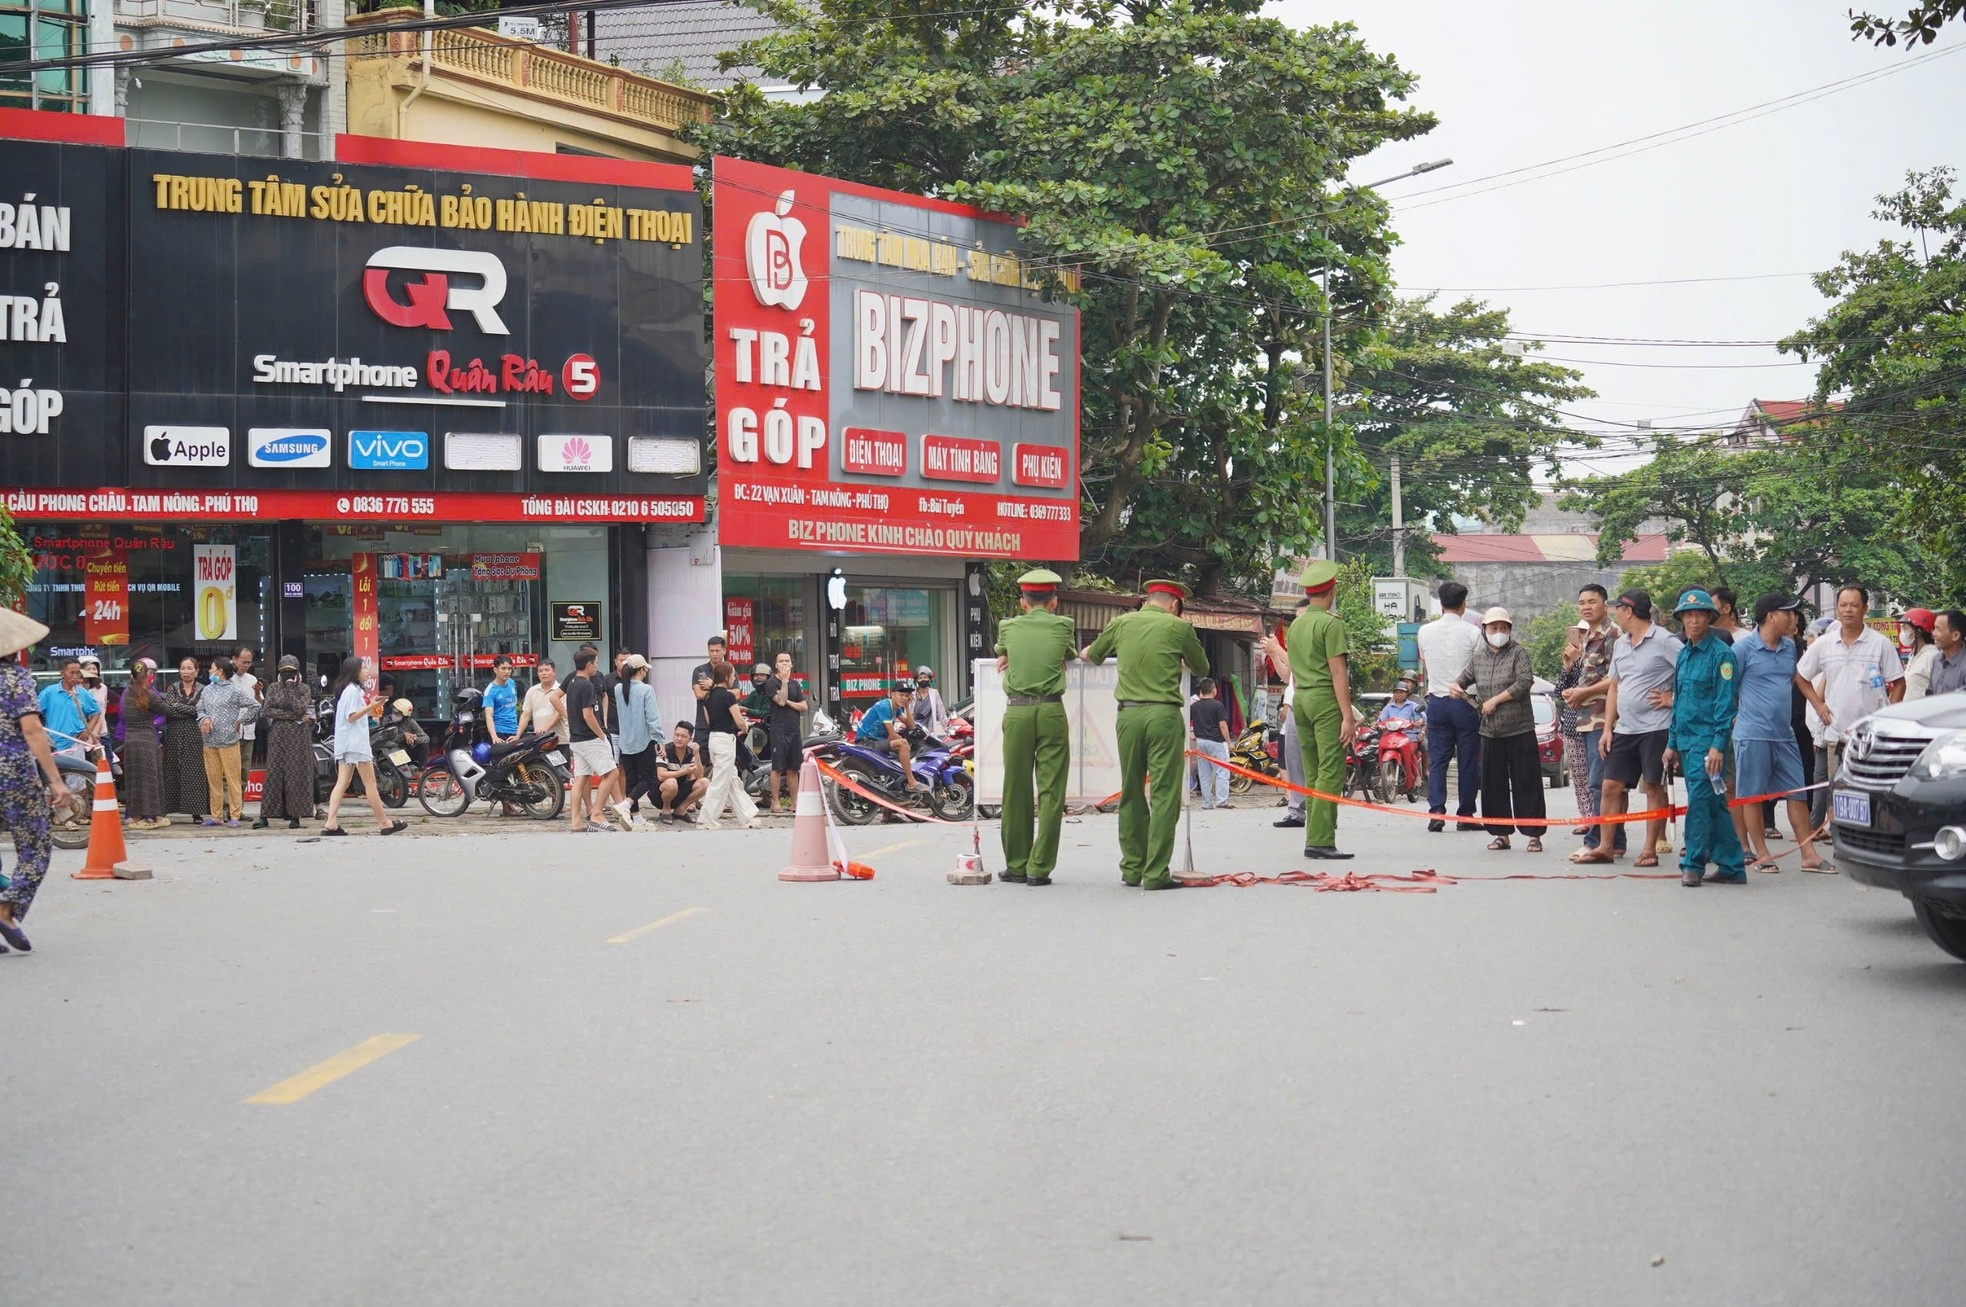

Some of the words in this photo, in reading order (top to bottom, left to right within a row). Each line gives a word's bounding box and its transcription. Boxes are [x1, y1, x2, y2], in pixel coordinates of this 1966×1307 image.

[0, 193, 70, 251] BÁN
[153, 174, 242, 213] TRUNG
[248, 174, 306, 218] TÂM
[310, 173, 365, 222] SỬA
[367, 185, 436, 227] CHỮA
[441, 184, 492, 230] BẢO
[496, 192, 564, 235] HÀNH
[568, 198, 623, 245] ĐIỆN
[626, 208, 692, 250] THOẠI
[363, 246, 510, 335] QR
[0, 282, 67, 342] TRẢ
[729, 318, 821, 391] TRẢ
[854, 289, 1061, 411] BIZPHONE
[253, 354, 417, 392] Smartphone
[427, 350, 497, 394] Quân
[501, 353, 553, 395] Râu
[571, 361, 597, 393] 5
[727, 397, 826, 469] GÓP
[174, 440, 226, 461] Apple
[264, 443, 318, 454] SAMSUNG
[849, 435, 872, 470] ĐIỆN
[874, 441, 903, 472] THOẠI
[928, 442, 948, 470] MÁY
[949, 443, 971, 473] TÍNH
[973, 443, 998, 475] BẢNG
[1022, 453, 1039, 483] PHỤ
[1041, 452, 1063, 484] KIỆN
[8, 488, 36, 511] CẦU
[39, 494, 86, 512] PHONG
[234, 495, 258, 517] THỌ
[353, 497, 384, 513] 0836
[386, 498, 409, 513] 776
[411, 498, 434, 514] 555
[522, 494, 552, 515] TỔNG
[555, 497, 574, 515] ĐÀI
[577, 498, 610, 516] CSKH:
[612, 500, 638, 516] 0210
[641, 500, 648, 516] 6
[650, 500, 693, 517] 505050
[734, 483, 750, 500] ĐC:
[751, 485, 762, 501] 22
[763, 486, 780, 505] VẠN
[781, 484, 804, 504] XUÂN
[811, 489, 829, 507] TAM
[829, 487, 851, 508] NÔNG
[856, 489, 873, 510] PHÚ
[873, 494, 889, 513] THỌ
[997, 501, 1028, 518] HOTLINE:
[33, 535, 111, 550] Smartphone
[114, 536, 147, 549] Quân
[150, 536, 175, 549] Râu
[788, 519, 814, 541] BIZ
[816, 521, 866, 543] PHONE
[868, 519, 904, 545] KÍNH
[905, 523, 944, 548] CHÀO
[946, 525, 975, 550] QUÝ
[976, 526, 1020, 551] KHÁCH
[198, 549, 214, 581] TRẢ
[214, 549, 232, 582] GÓP
[474, 555, 491, 563] Mua
[52, 583, 69, 593] TNHH
[157, 583, 180, 592] MOBILE
[286, 584, 301, 592] 100
[93, 600, 121, 621] 24h
[970, 607, 981, 625] PHỤ
[729, 624, 751, 646] 50%
[969, 630, 983, 651] KIỆN
[846, 679, 858, 691] BIZ
[859, 679, 881, 691] PHONE
